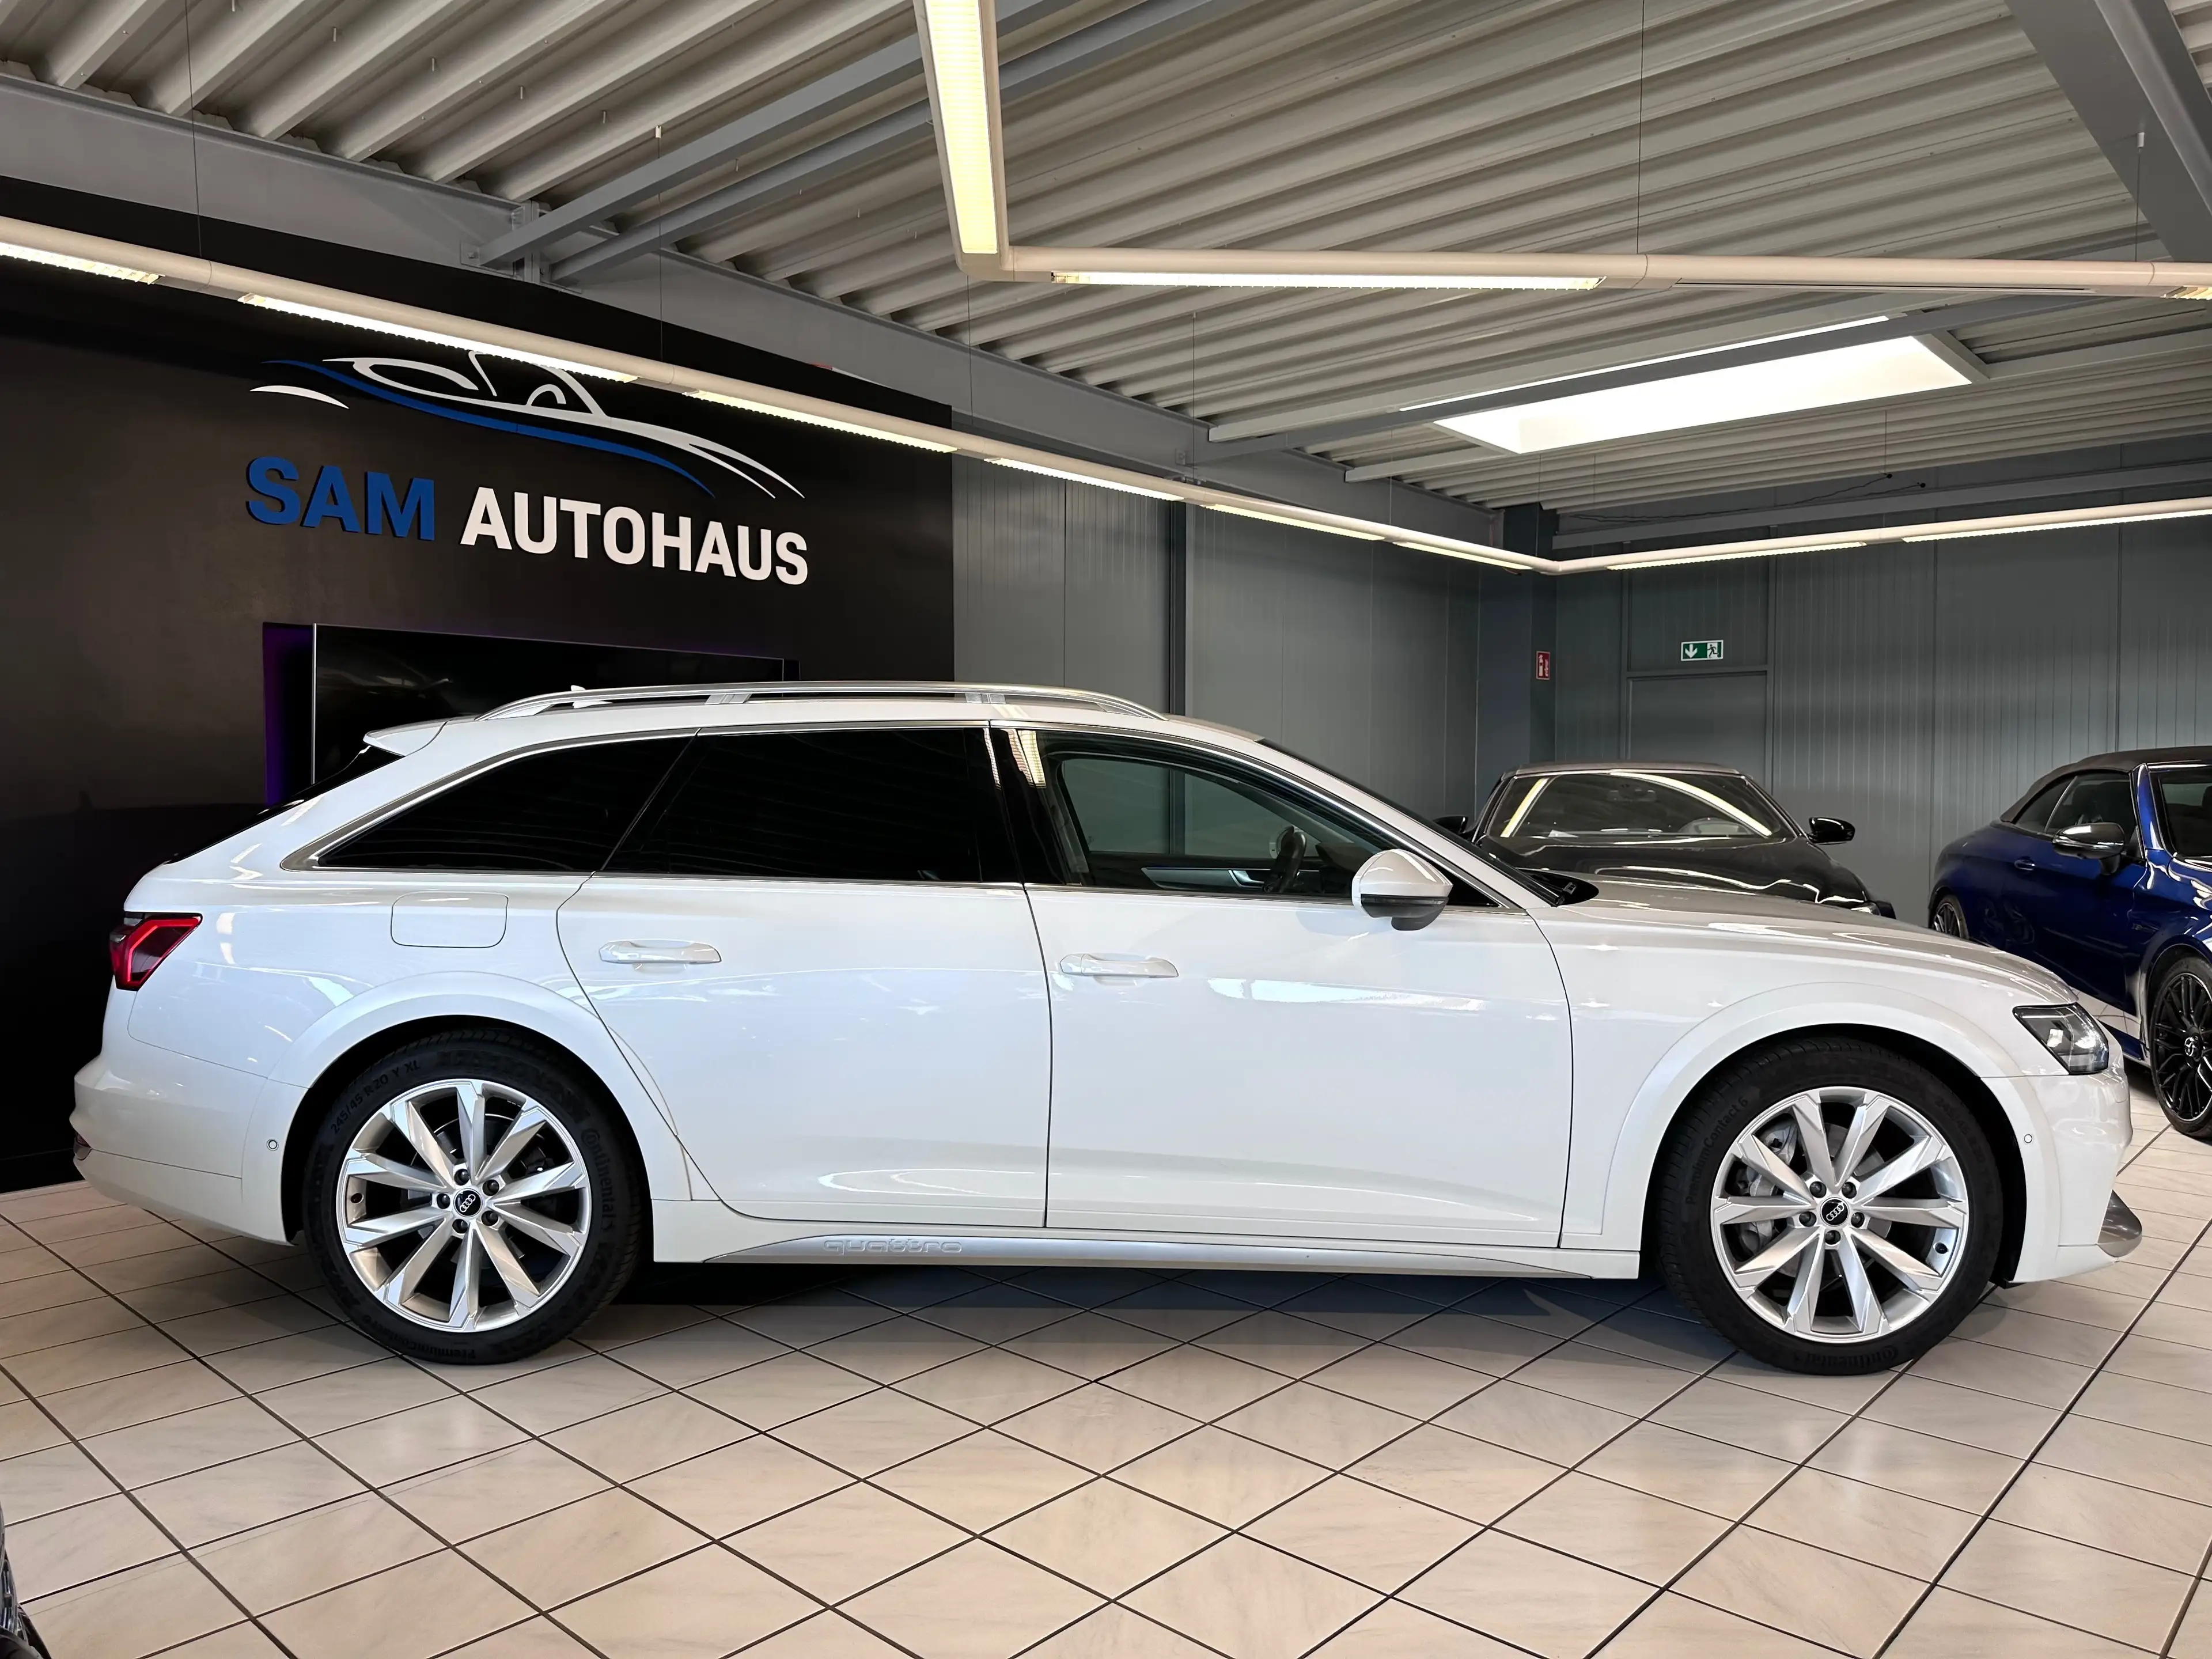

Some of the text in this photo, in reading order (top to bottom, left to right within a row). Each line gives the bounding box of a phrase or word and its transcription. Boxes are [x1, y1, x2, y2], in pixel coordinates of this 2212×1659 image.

[246, 457, 808, 586] SAM AUTOHAUS
[331, 1093, 363, 1134] 245/45
[392, 1067, 399, 1077] Y
[404, 1060, 421, 1073] XL
[581, 1127, 616, 1218] Continental
[1685, 1096, 1748, 1205] PremiumContact 6
[824, 1239, 961, 1255] quattro
